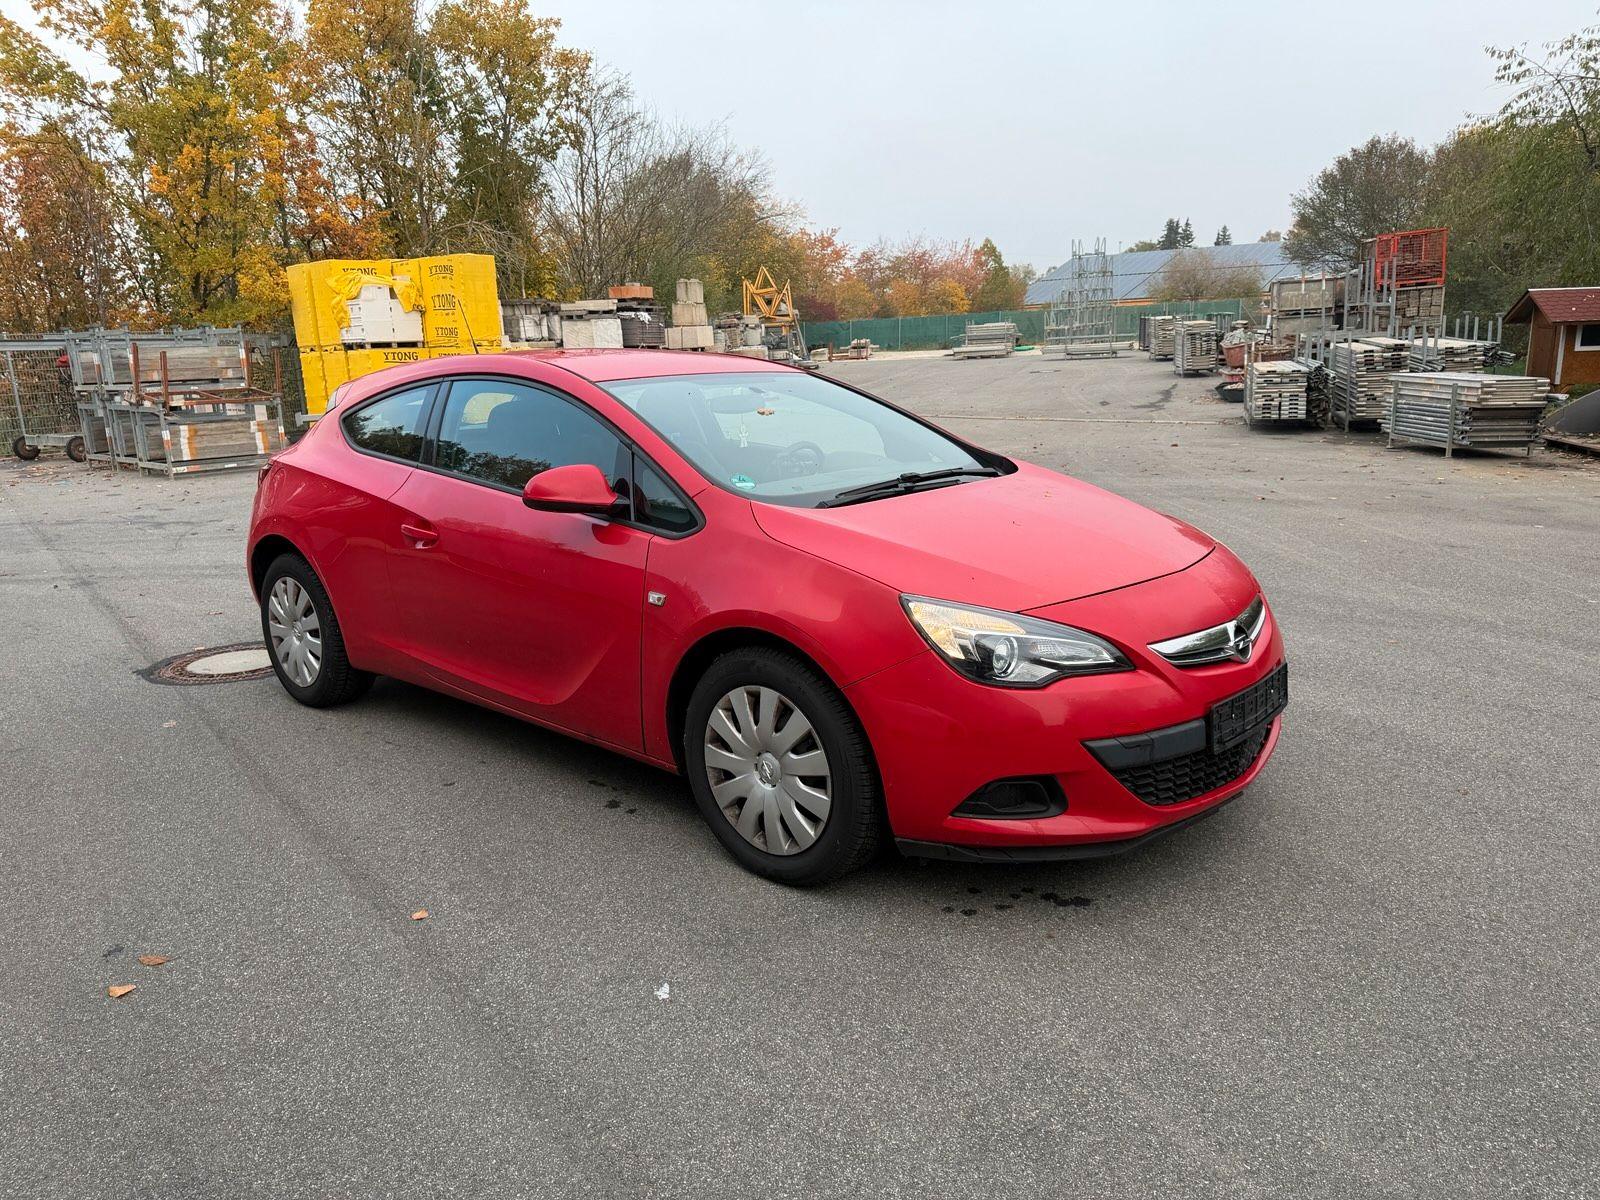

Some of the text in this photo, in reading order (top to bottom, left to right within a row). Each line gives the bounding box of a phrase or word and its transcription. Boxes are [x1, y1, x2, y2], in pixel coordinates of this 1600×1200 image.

[429, 264, 454, 274] YTONG
[432, 294, 456, 308] YTONG
[435, 327, 459, 336] YTONG
[383, 352, 419, 361] YTONG
